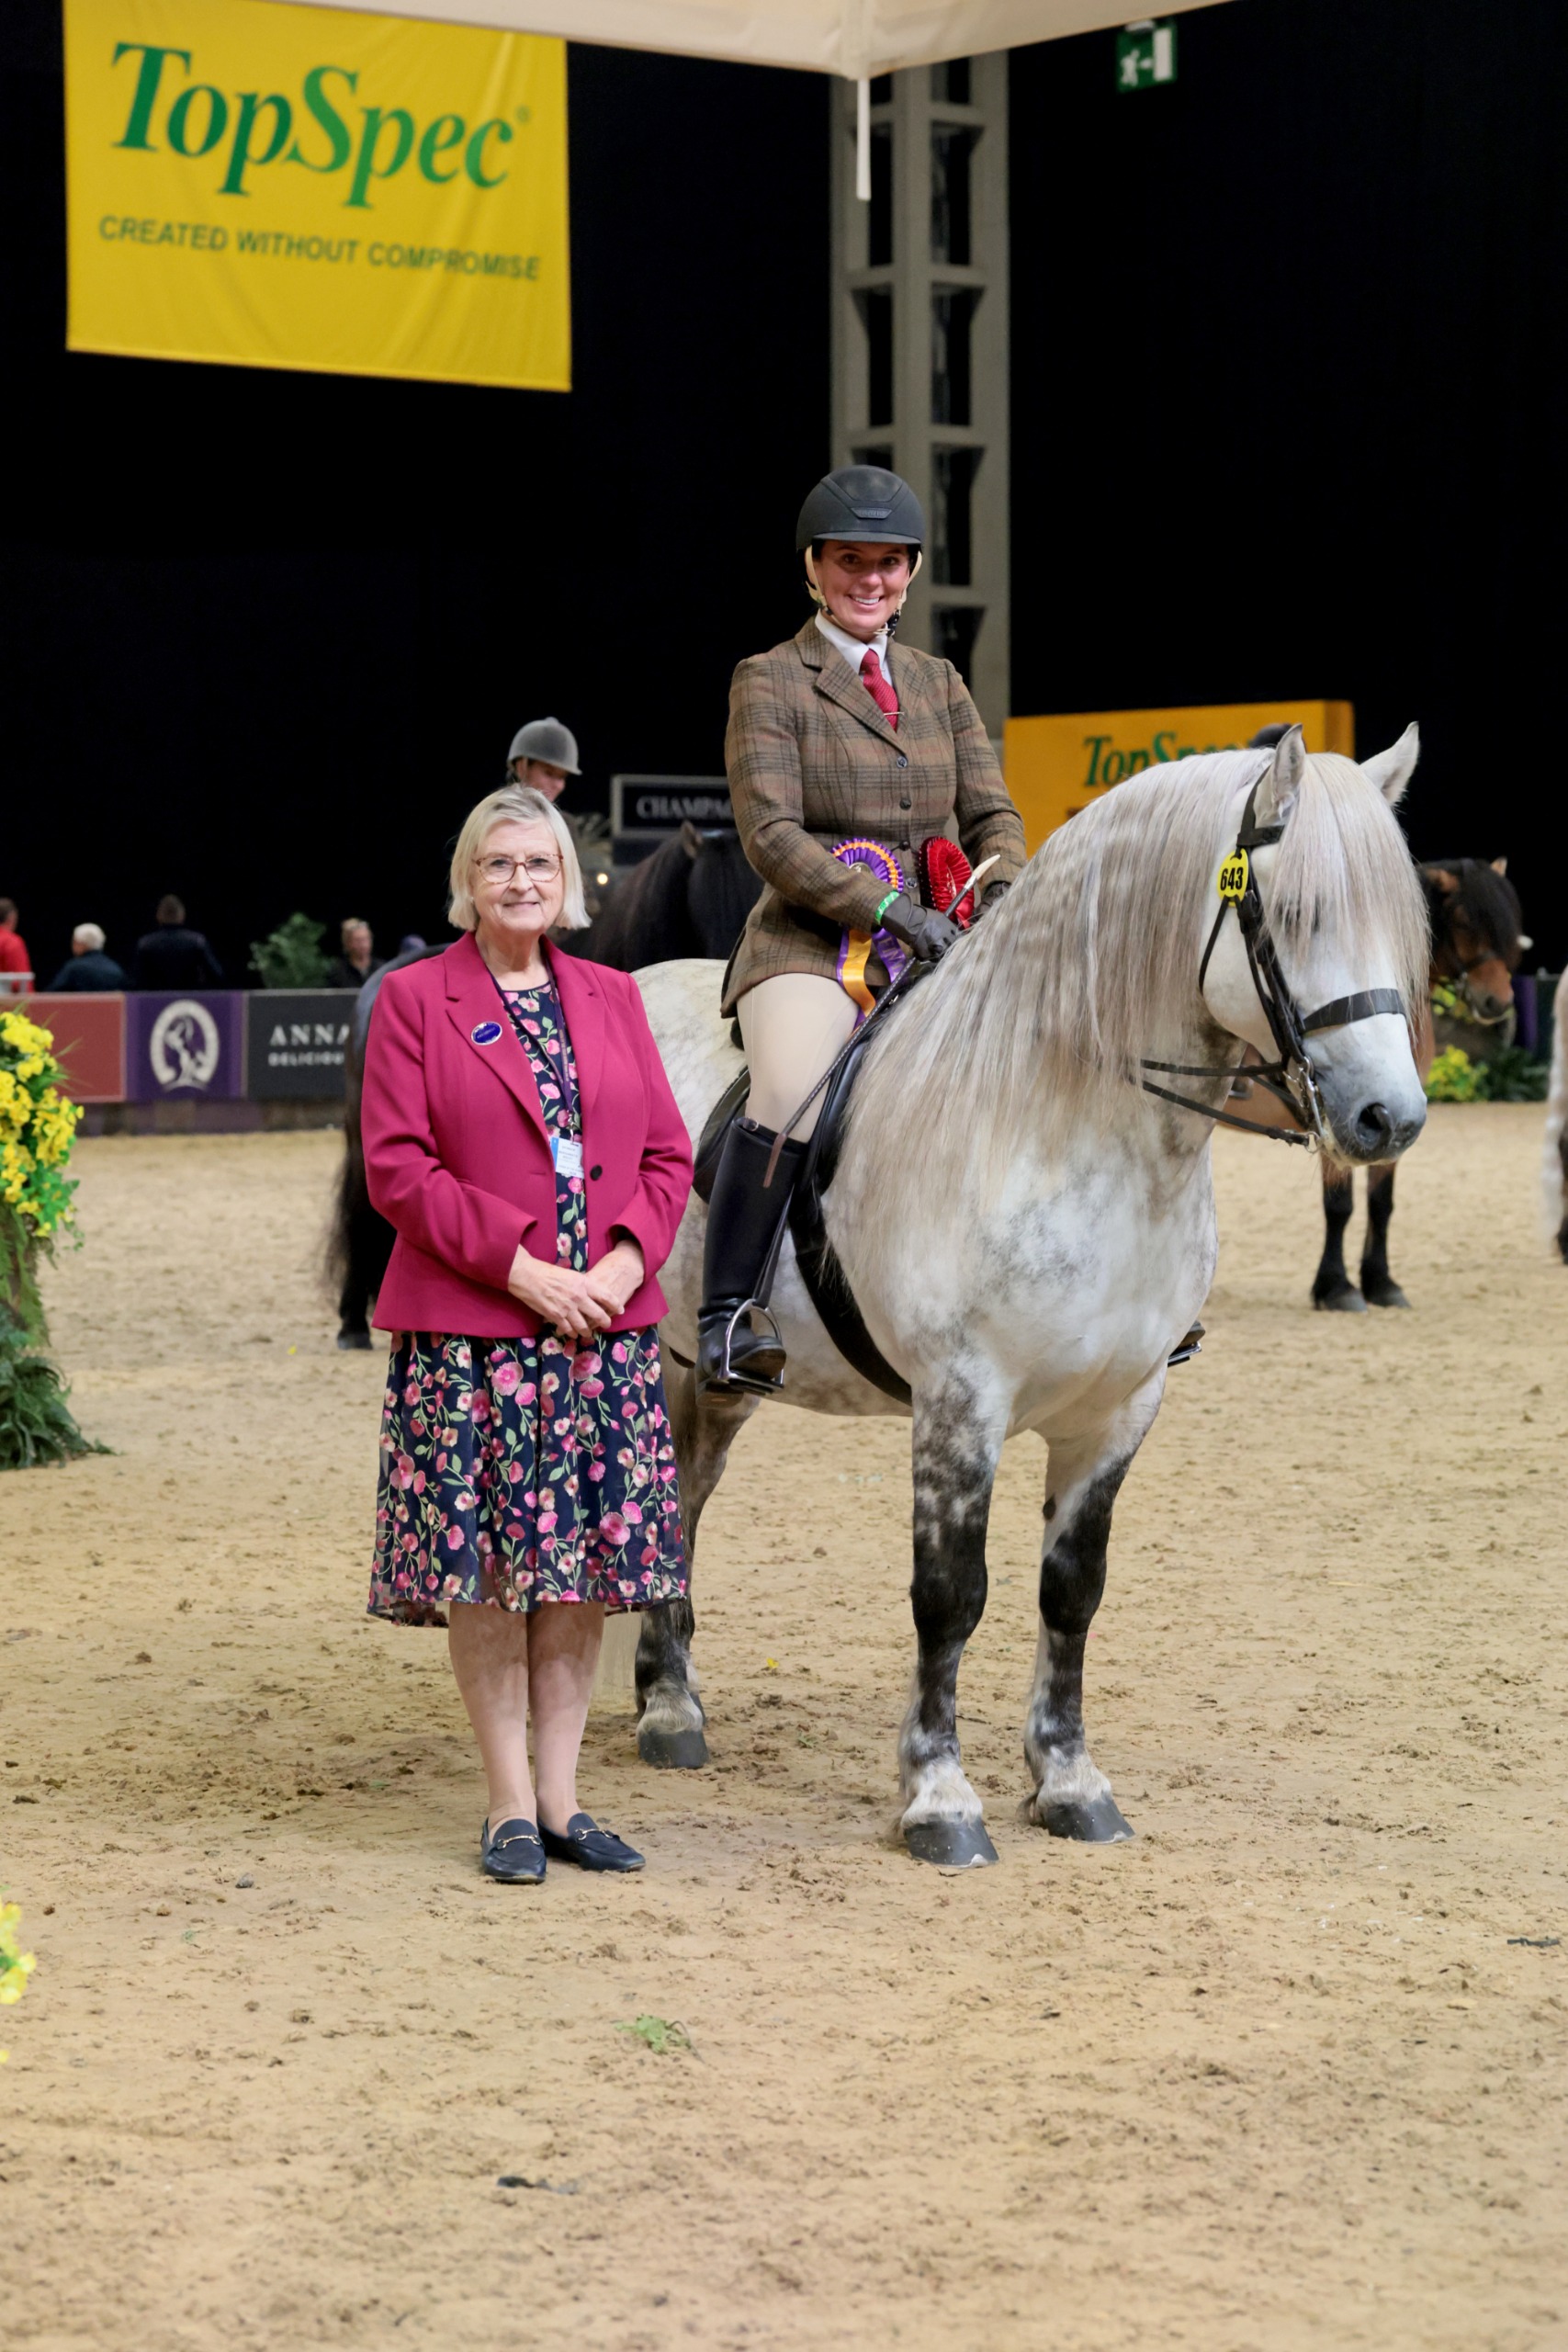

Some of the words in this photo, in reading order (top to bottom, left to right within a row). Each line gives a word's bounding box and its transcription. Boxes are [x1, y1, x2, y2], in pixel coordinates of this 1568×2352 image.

[111, 41, 513, 210] TopSpec
[98, 215, 229, 252] CREATED
[236, 230, 360, 262] WITHOUT
[367, 242, 540, 281] COMPROMISE
[1220, 866, 1244, 891] 643
